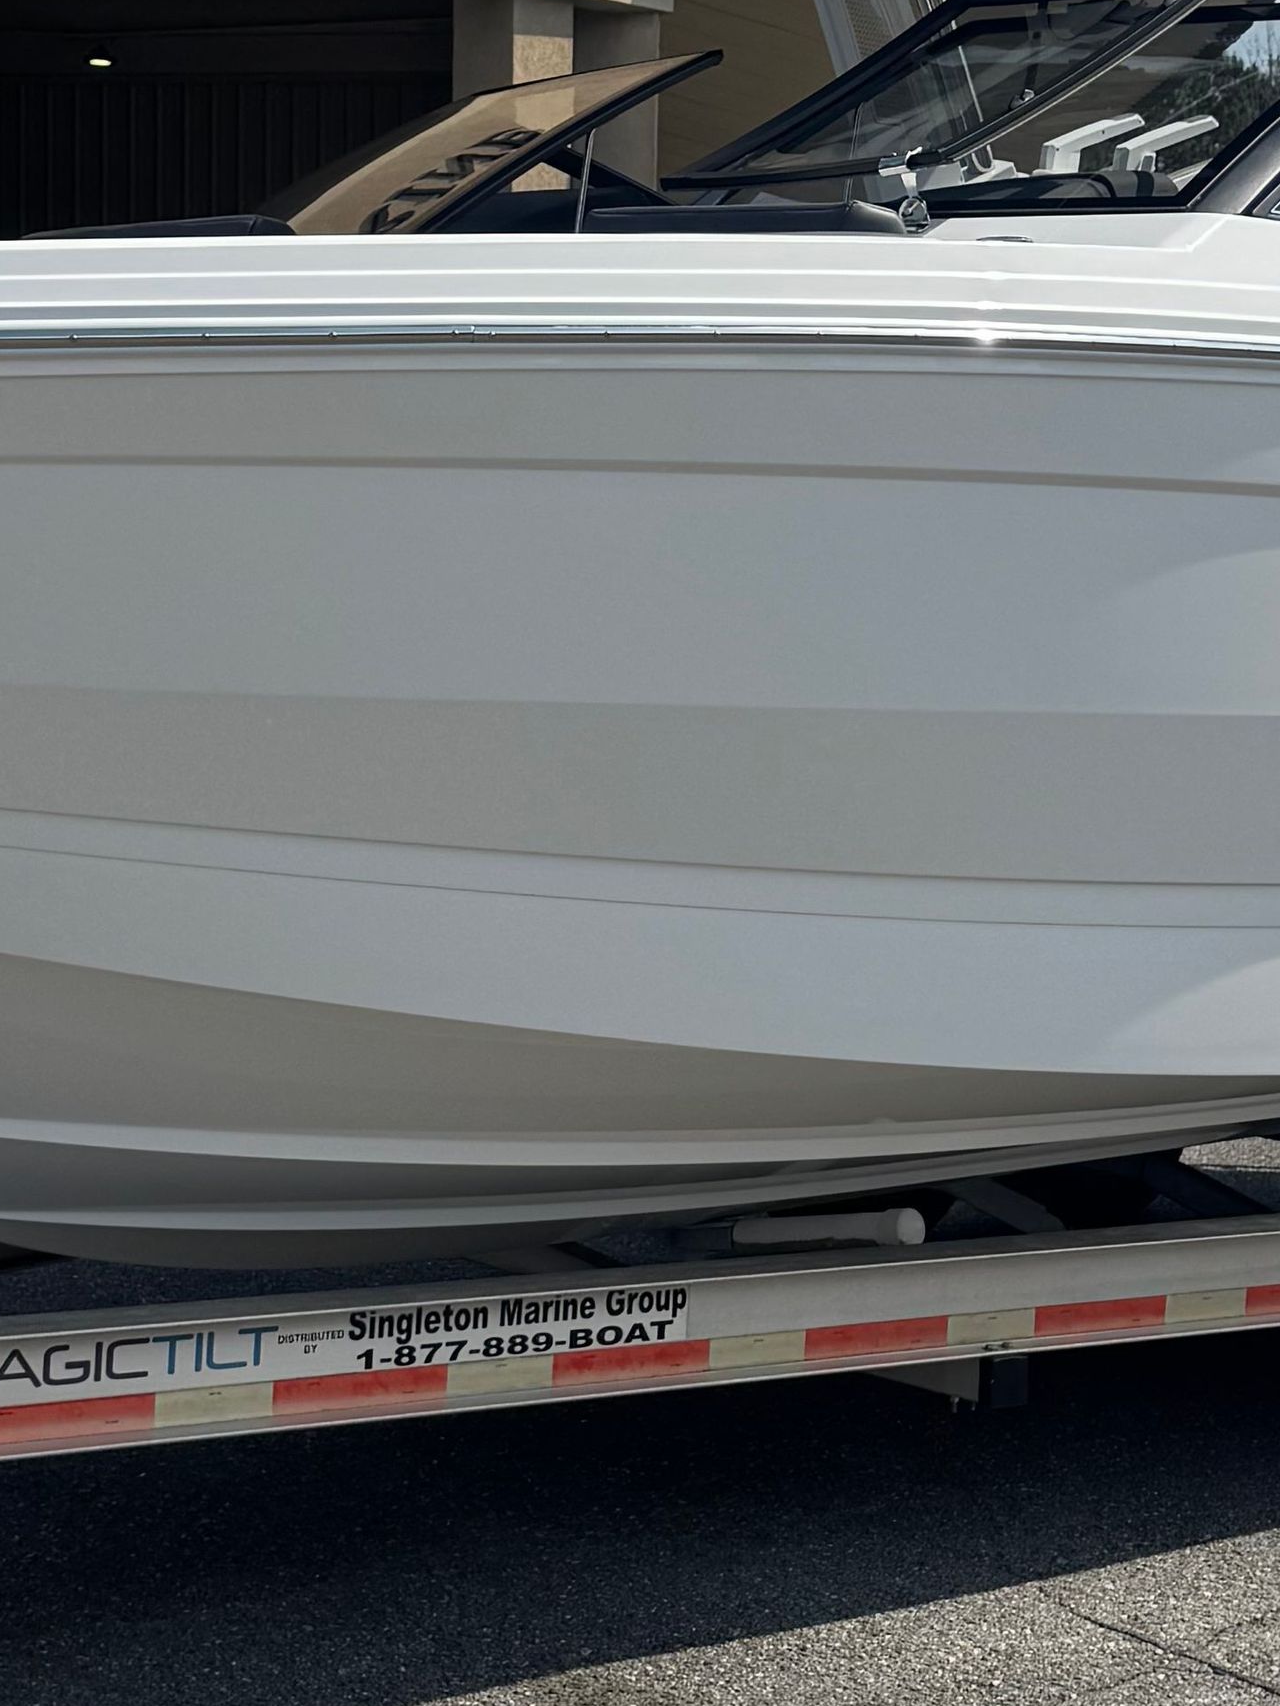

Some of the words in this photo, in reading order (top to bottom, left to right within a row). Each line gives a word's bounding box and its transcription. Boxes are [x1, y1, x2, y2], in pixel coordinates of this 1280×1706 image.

[277, 1329, 345, 1344] DISTRIBUTED
[348, 1304, 489, 1345] Singleton
[499, 1295, 596, 1327] Marine
[605, 1287, 688, 1318] Group
[356, 1319, 674, 1370] 1-877-889-BOAT
